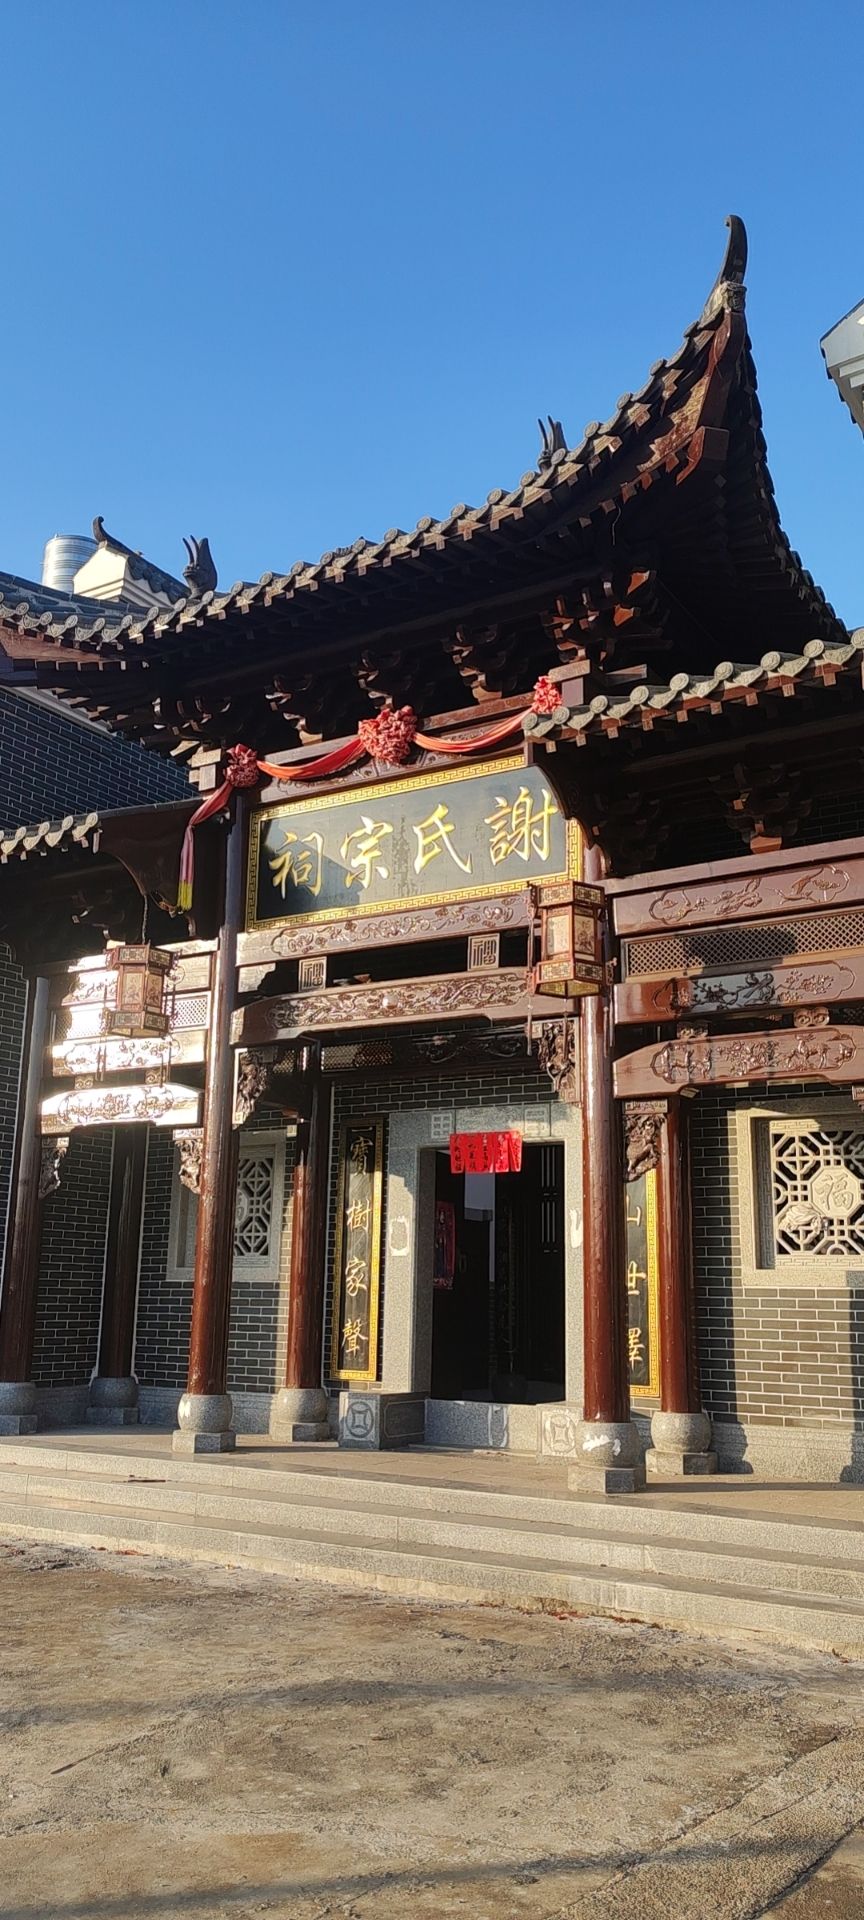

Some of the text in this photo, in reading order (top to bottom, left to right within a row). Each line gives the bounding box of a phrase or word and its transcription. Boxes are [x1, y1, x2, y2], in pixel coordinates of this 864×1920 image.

[268, 786, 559, 899] 謝氏宗祠
[814, 1173, 854, 1212] 福
